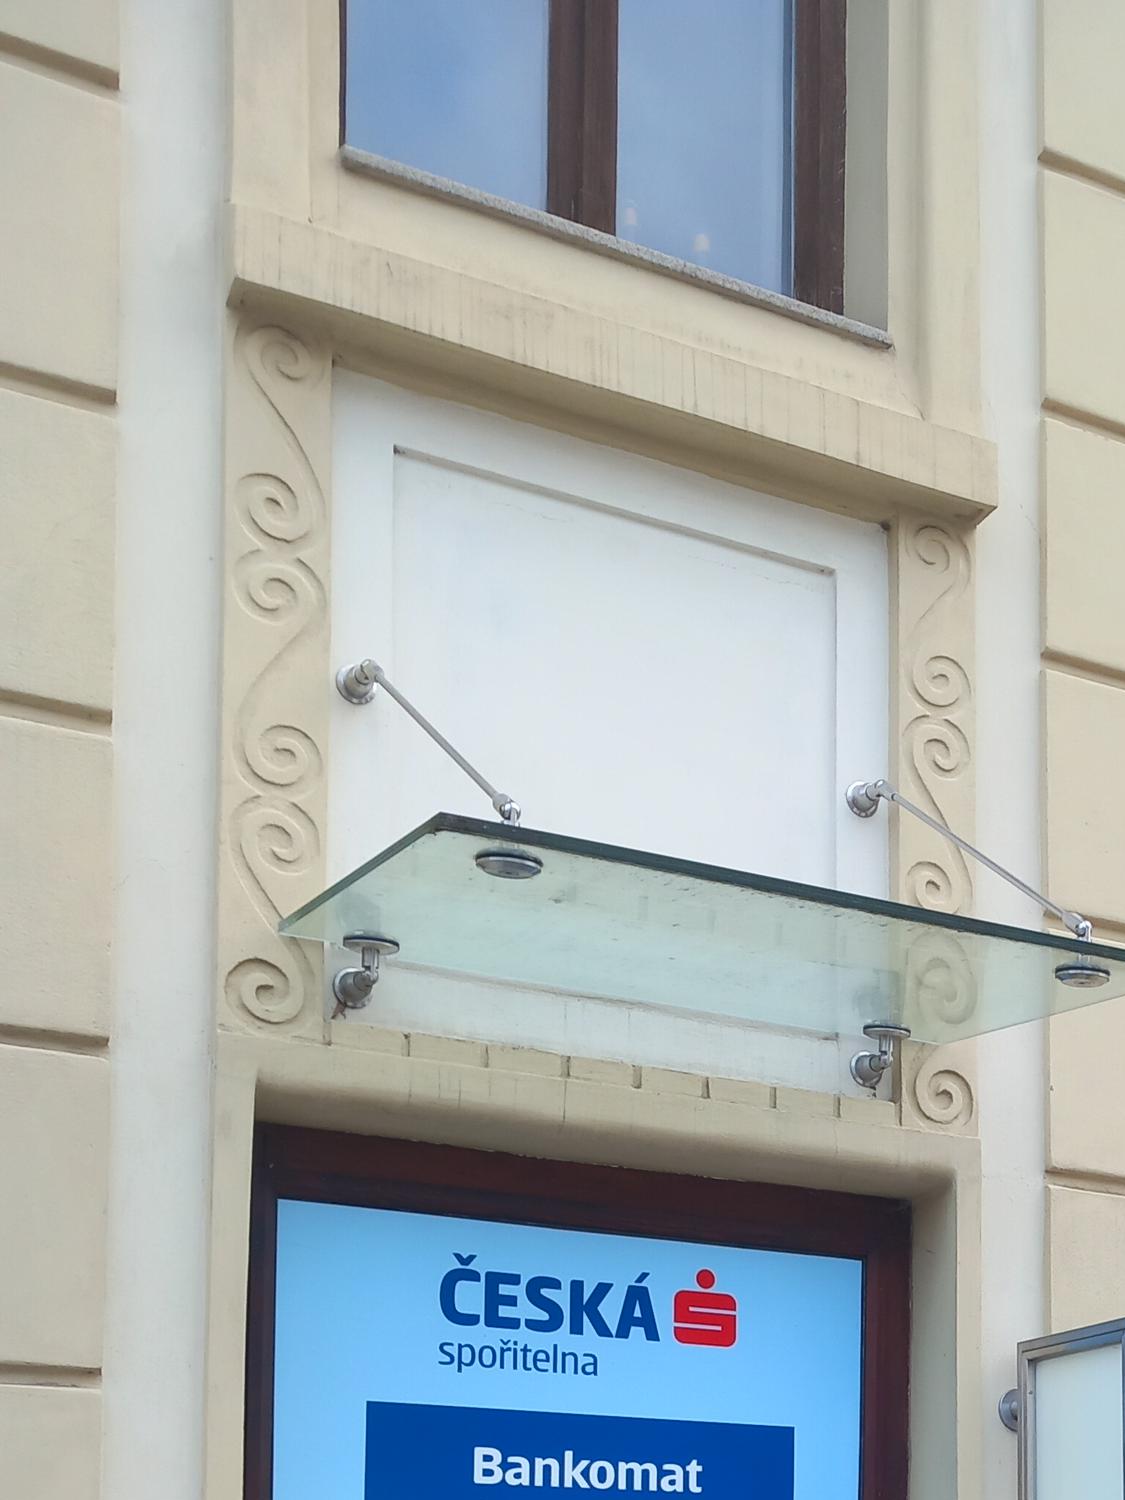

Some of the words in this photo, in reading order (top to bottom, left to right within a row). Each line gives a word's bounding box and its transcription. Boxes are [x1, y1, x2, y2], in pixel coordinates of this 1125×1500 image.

[438, 1251, 661, 1343] ČESKÁ
[437, 1338, 599, 1377] spořitelna
[473, 1446, 703, 1493] Bankomat
